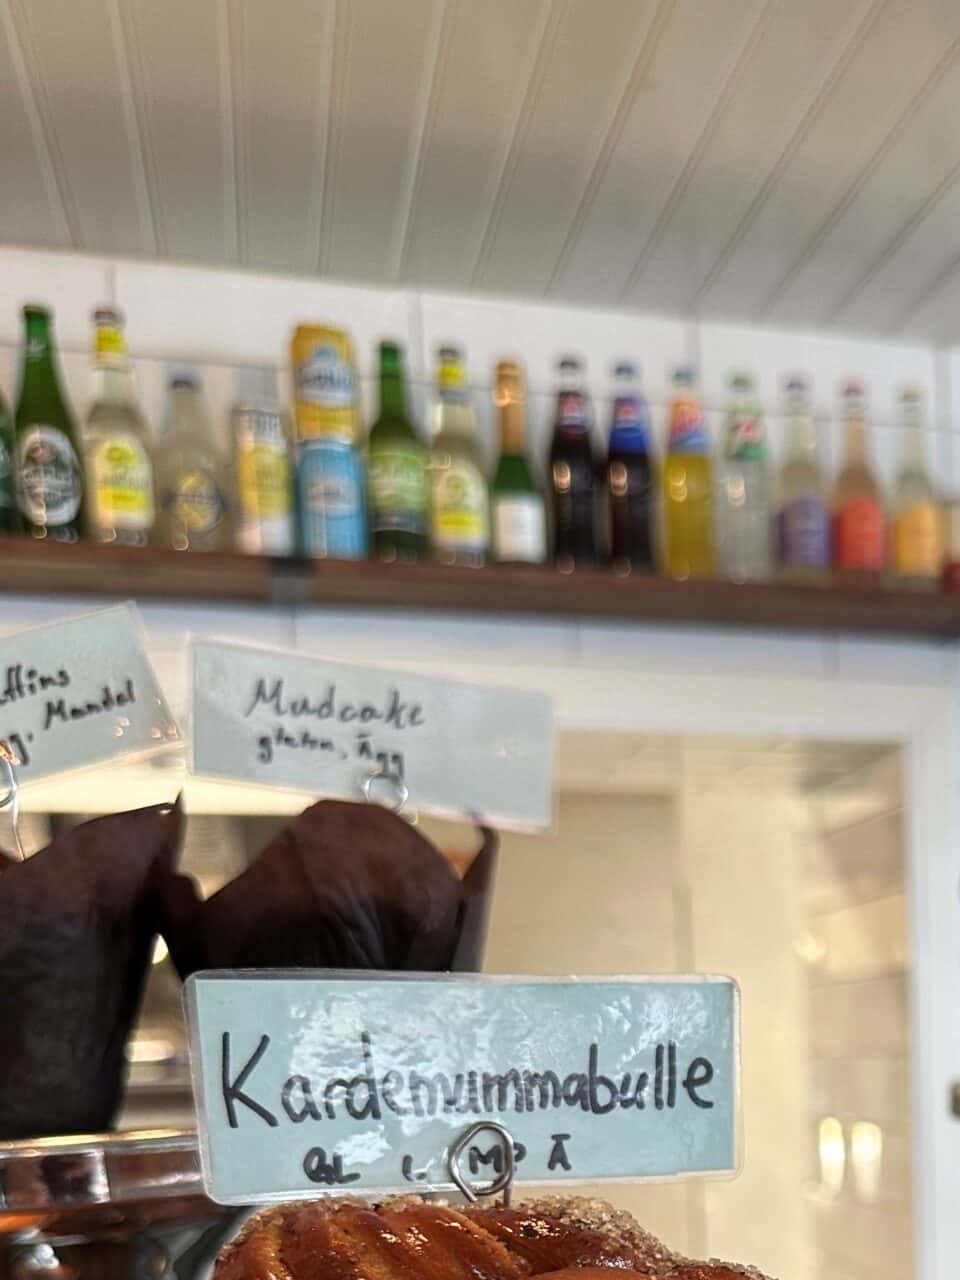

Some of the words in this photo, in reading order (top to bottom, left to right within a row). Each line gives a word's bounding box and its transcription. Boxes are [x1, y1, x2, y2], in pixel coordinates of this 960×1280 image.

[0, 663, 70, 706] ffins
[43, 676, 136, 731] Mandel
[245, 678, 426, 730] Mudcake
[221, 1030, 715, 1129] Kardemummabulle
